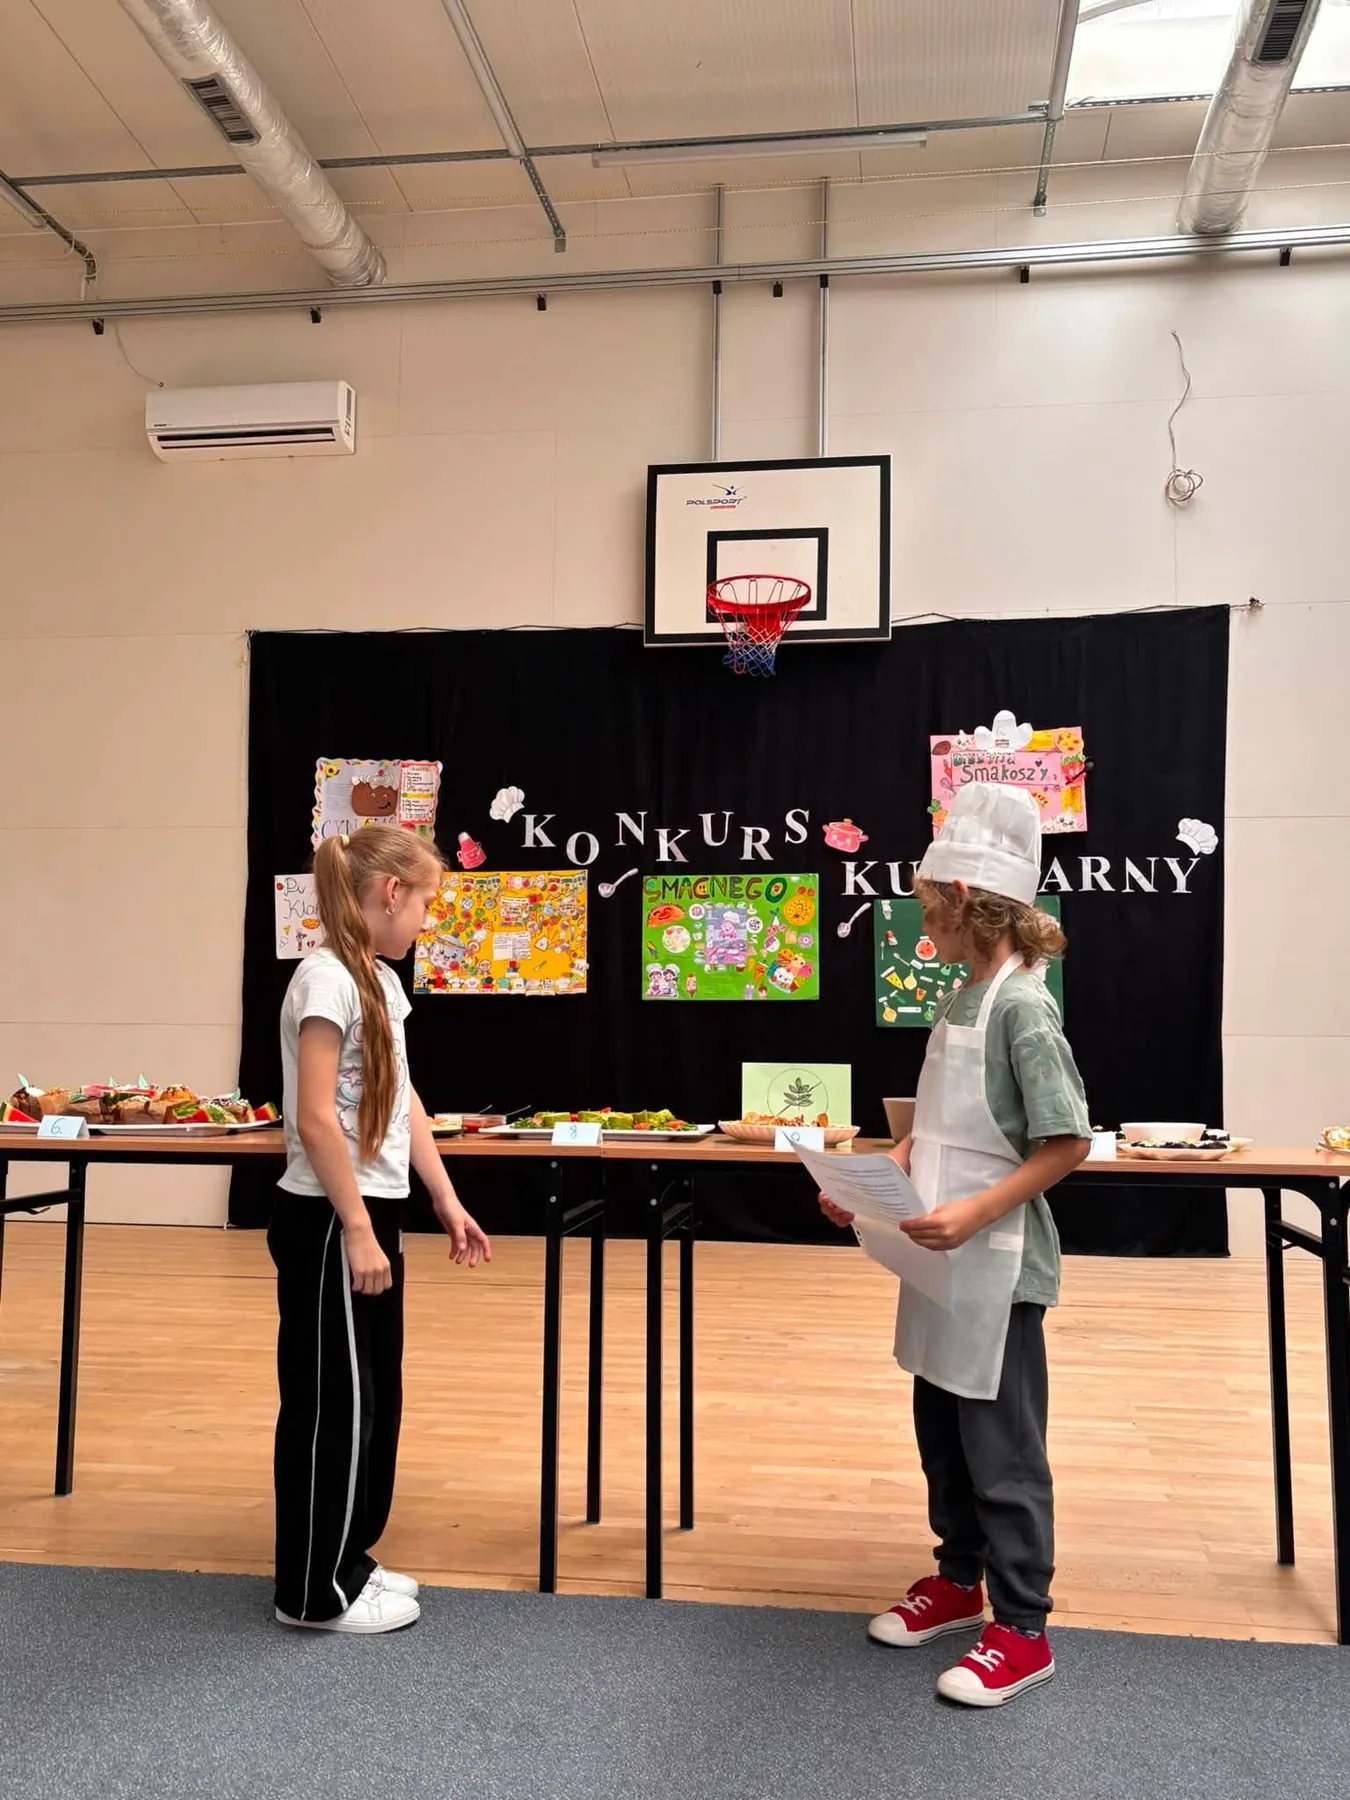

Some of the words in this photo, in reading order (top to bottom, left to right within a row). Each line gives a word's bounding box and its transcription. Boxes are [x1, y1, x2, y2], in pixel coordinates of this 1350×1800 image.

[686, 498, 744, 506] POLSPORT
[960, 765, 1049, 784] Smakoszy
[521, 808, 810, 866] KONKURS
[840, 856, 1201, 896] KUARNY
